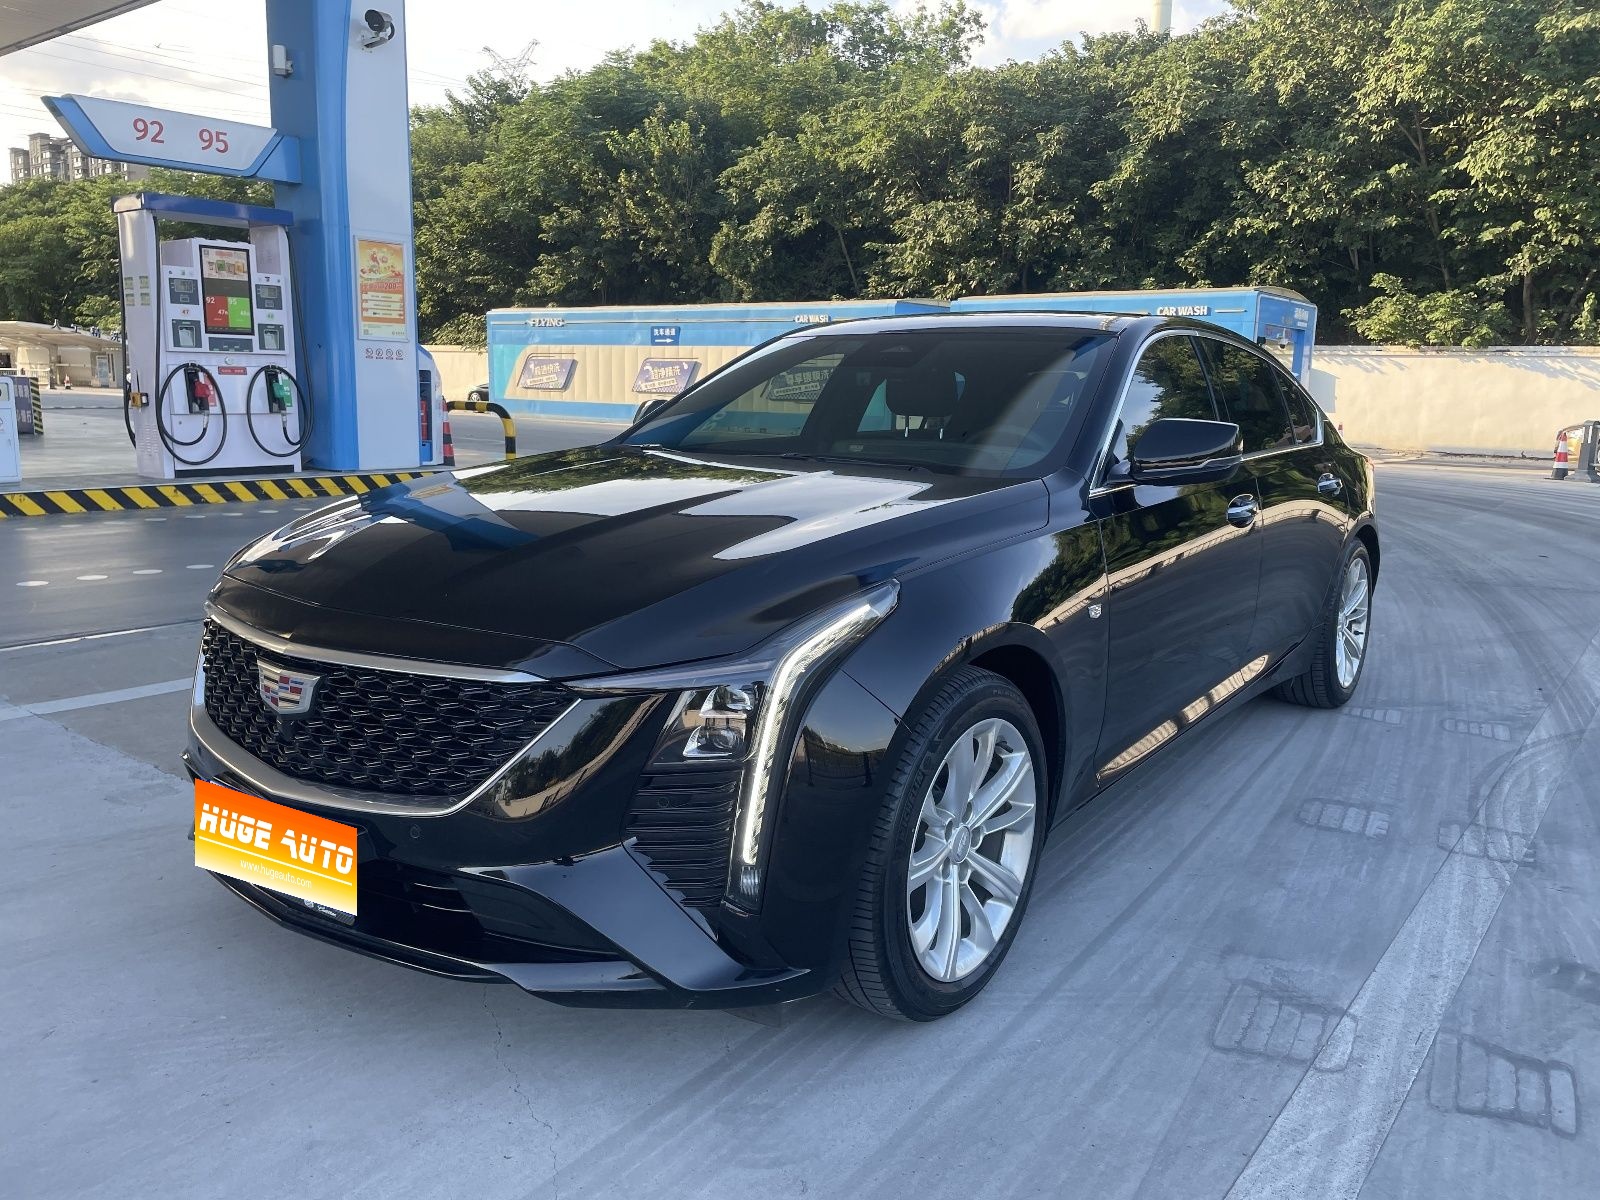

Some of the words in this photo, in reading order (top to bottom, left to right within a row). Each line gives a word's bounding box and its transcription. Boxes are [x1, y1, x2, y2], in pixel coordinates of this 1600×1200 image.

[132, 117, 165, 144] 92
[198, 128, 229, 154] 95
[205, 296, 216, 304] 92
[1156, 306, 1177, 316] CAR
[1178, 305, 1208, 316] WASH
[529, 317, 566, 328] FLYING
[794, 315, 808, 323] CAR
[808, 314, 829, 323] WASH
